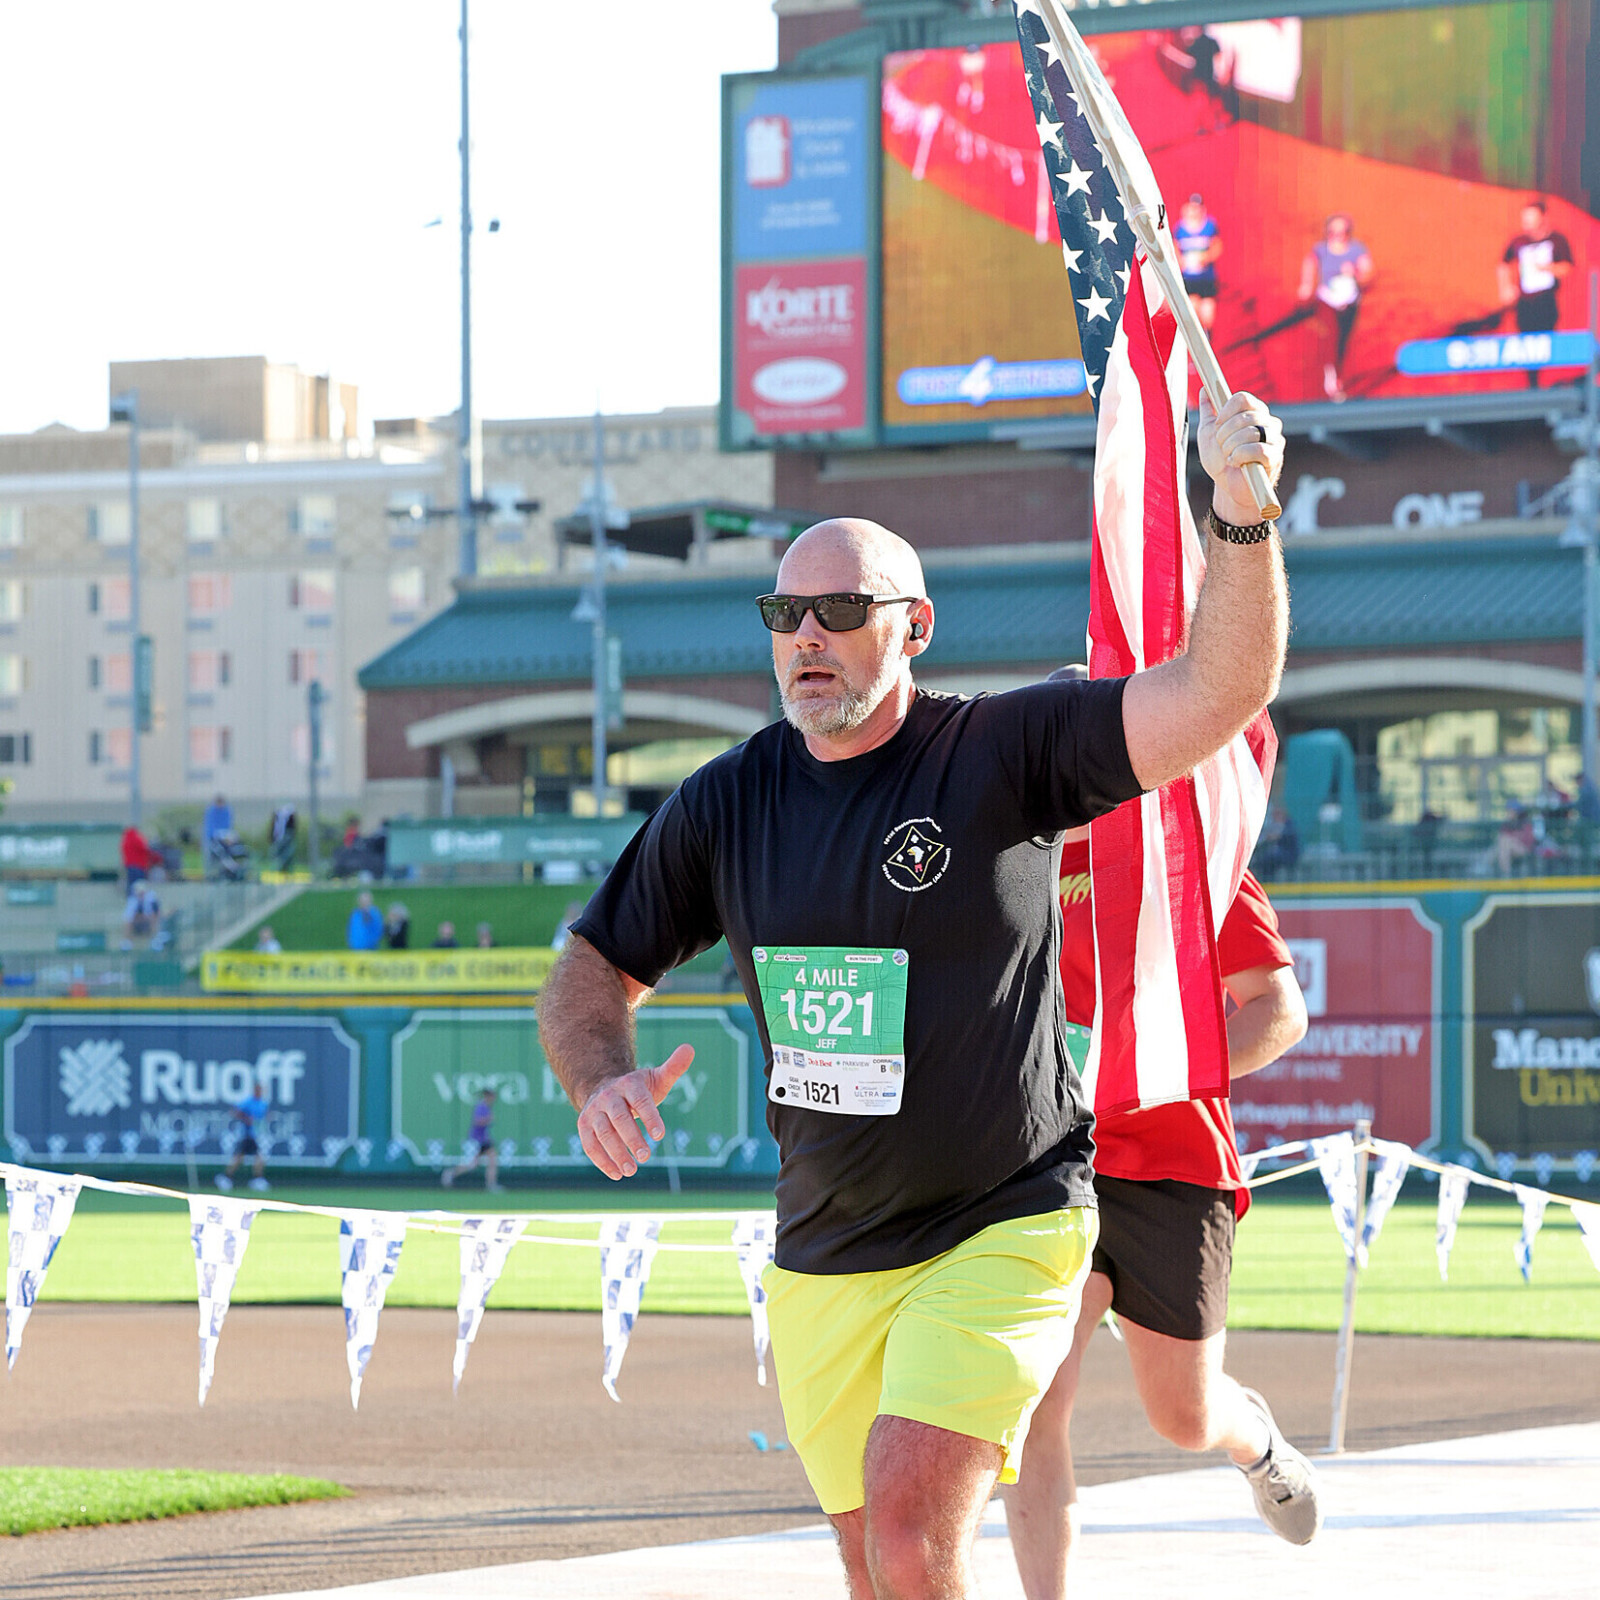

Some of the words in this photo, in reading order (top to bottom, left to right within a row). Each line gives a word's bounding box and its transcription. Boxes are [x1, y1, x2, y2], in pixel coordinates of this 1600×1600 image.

[1501, 335, 1551, 364] AM
[1393, 491, 1484, 530] ONE
[795, 968, 807, 986] 4
[812, 968, 858, 987] MILE
[780, 988, 874, 1036] 1521
[815, 1038, 838, 1049] JEFF
[140, 1049, 306, 1105] Ruoff
[880, 1065, 887, 1073] B
[788, 1083, 801, 1091] CHECK
[803, 1080, 840, 1105] 1521
[140, 1110, 304, 1143] MORTGGE
